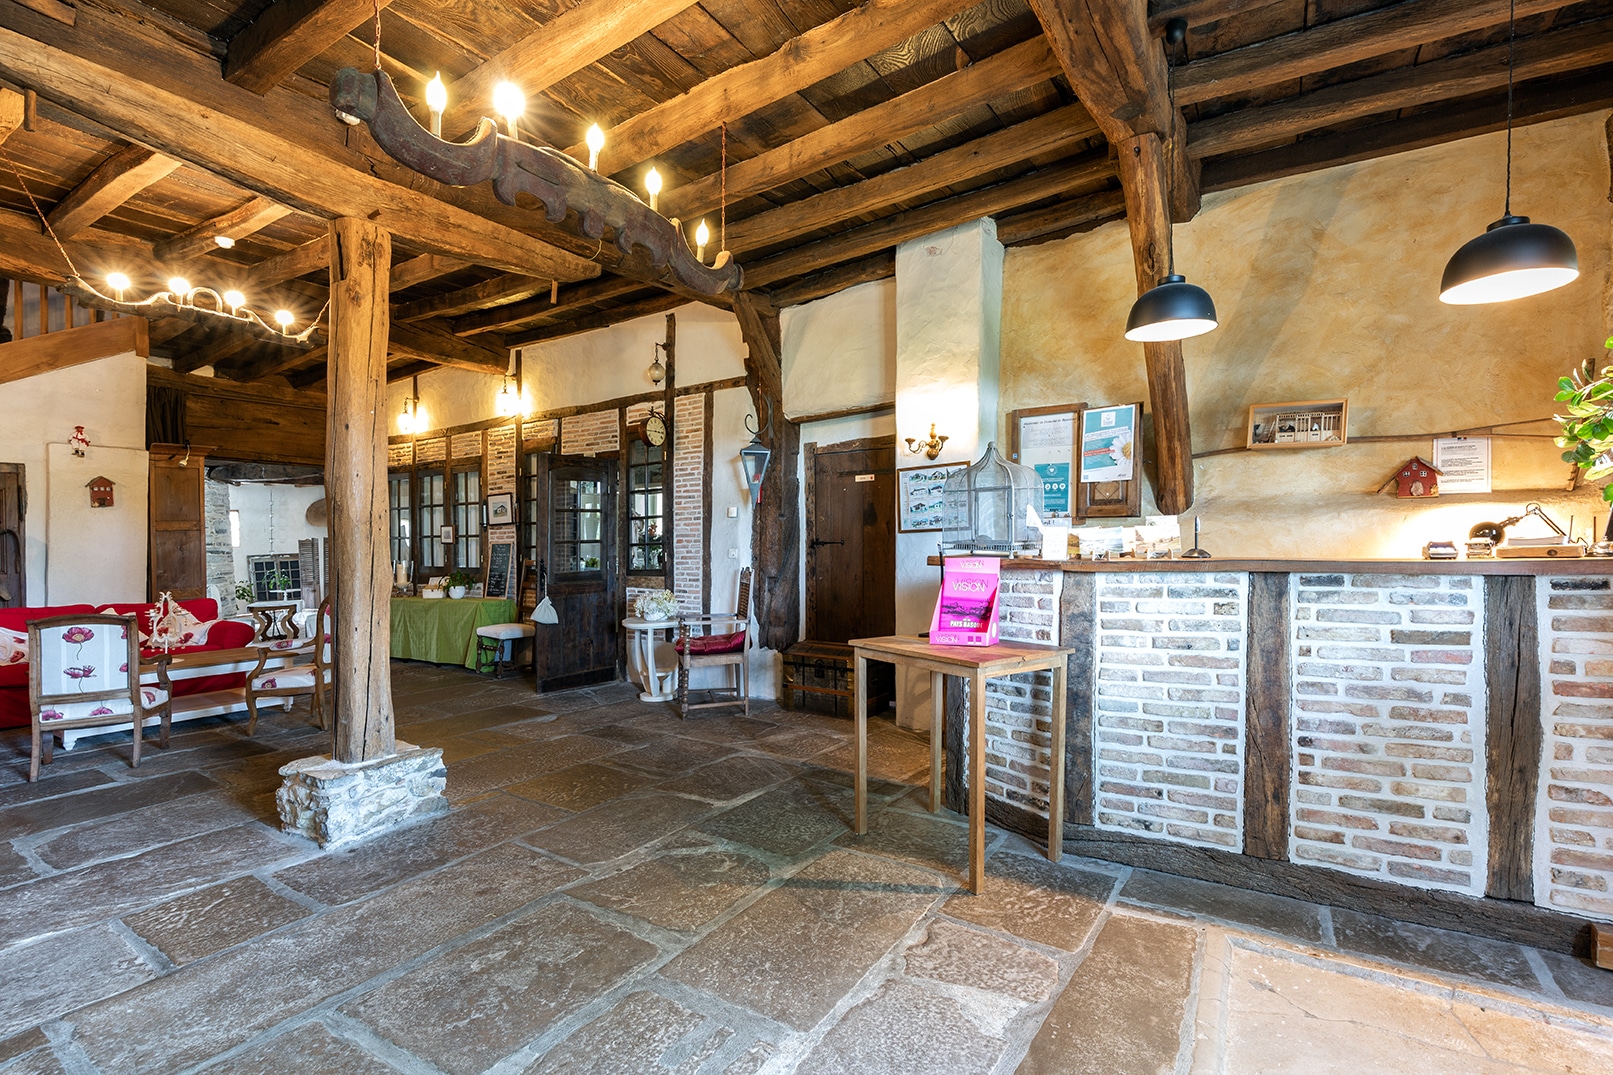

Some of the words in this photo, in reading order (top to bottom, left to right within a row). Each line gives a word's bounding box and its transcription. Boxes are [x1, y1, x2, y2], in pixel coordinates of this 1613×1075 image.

[959, 560, 984, 569] VISION
[952, 579, 989, 592] VISION
[950, 620, 963, 628] PAYS
[935, 634, 960, 644] VISION
